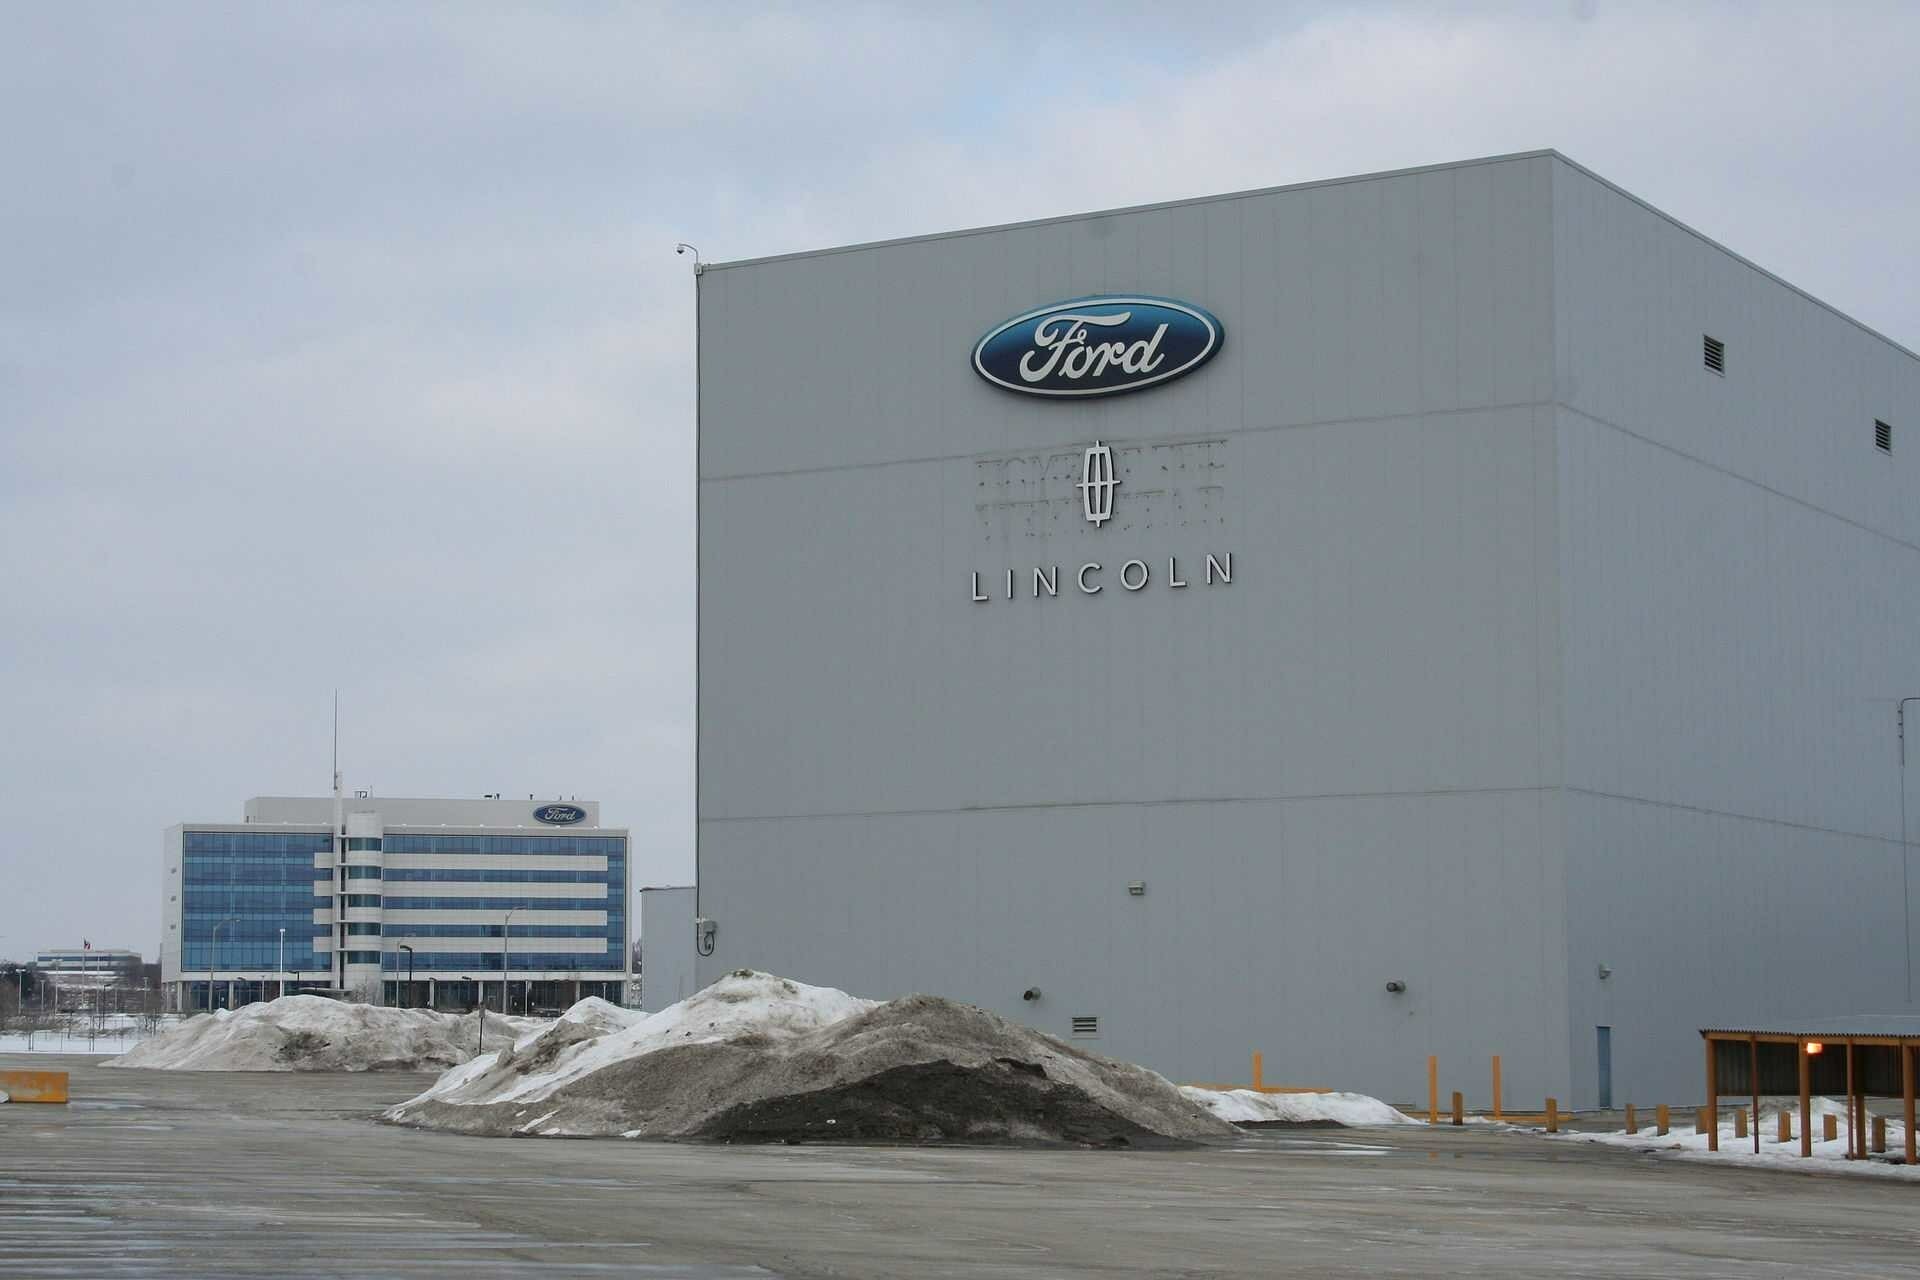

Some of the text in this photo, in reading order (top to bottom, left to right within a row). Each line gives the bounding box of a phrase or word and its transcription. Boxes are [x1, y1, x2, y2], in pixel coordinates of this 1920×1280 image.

[1019, 311, 1168, 383] Ford
[972, 551, 1233, 601] LINCOLN
[545, 807, 576, 820] Ford
